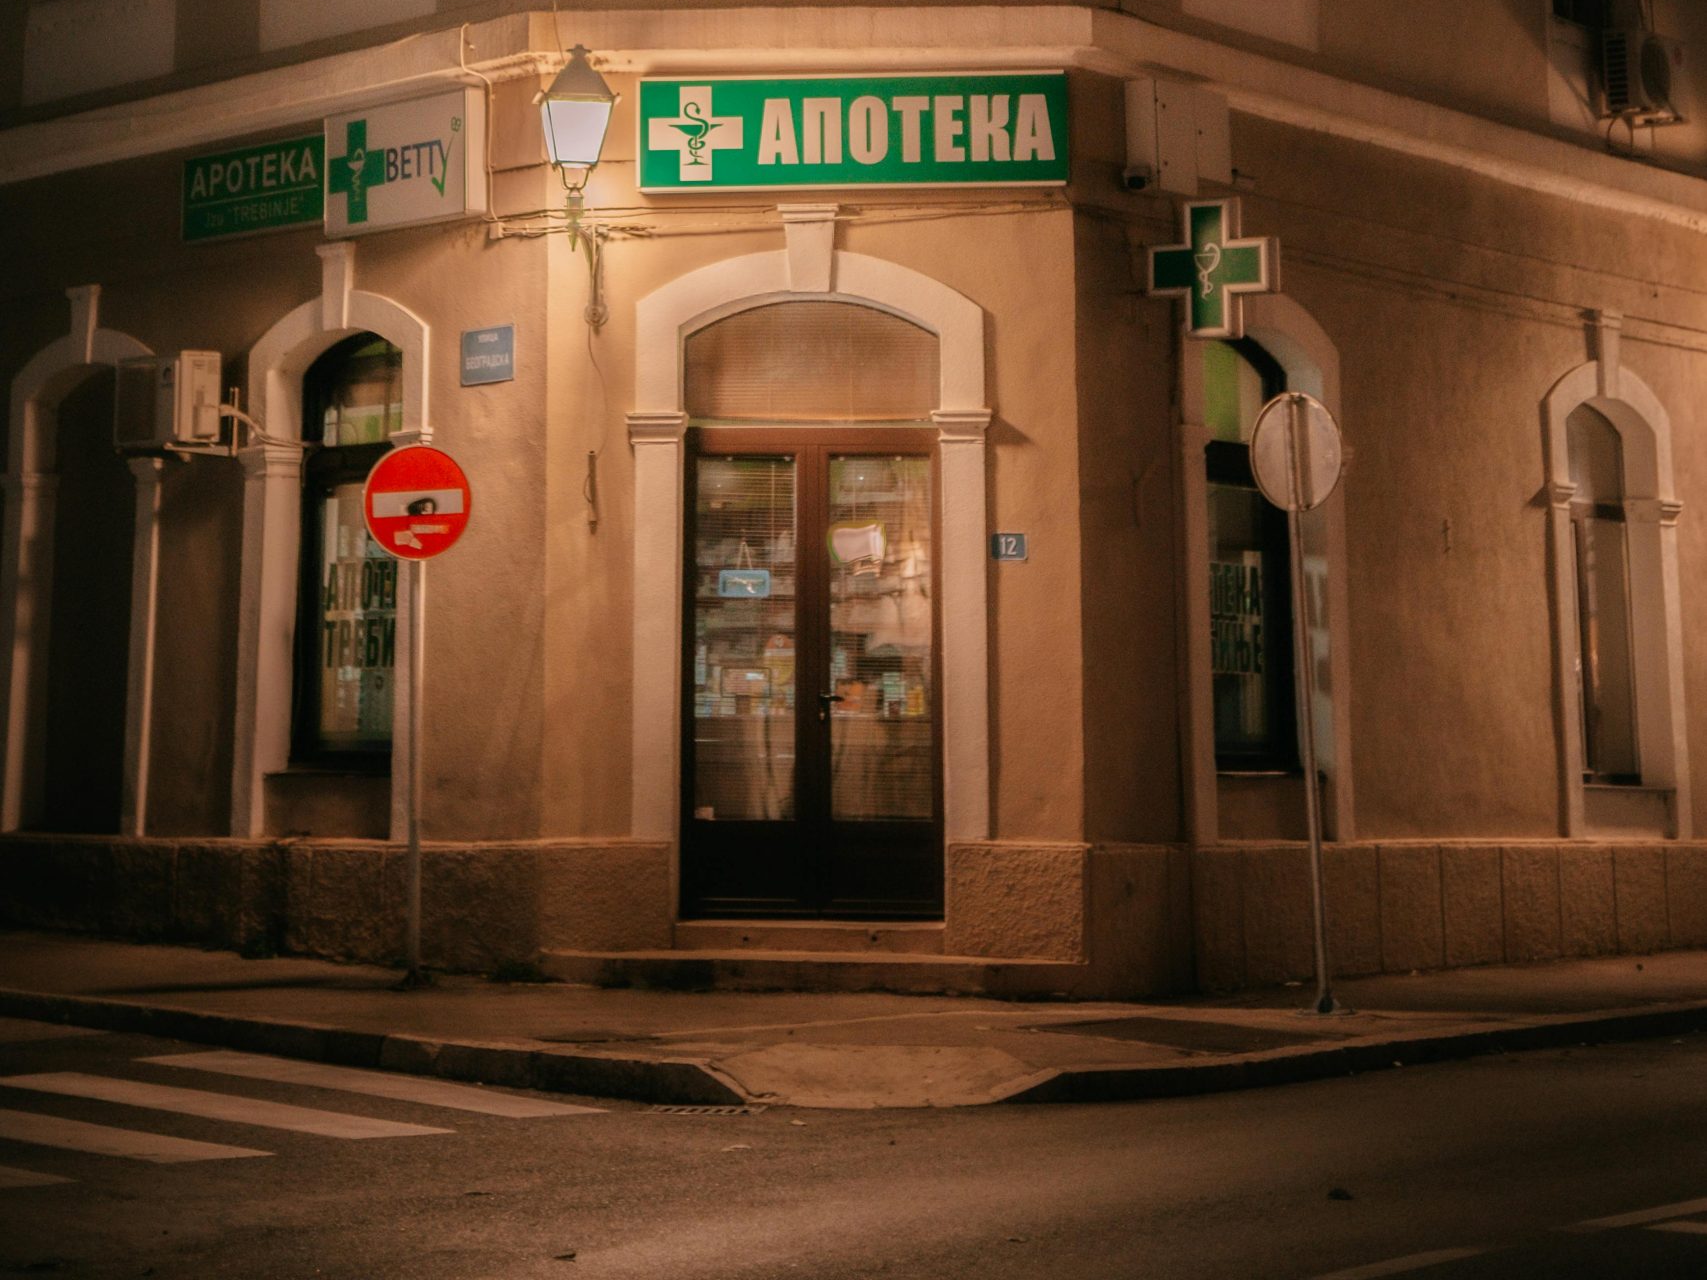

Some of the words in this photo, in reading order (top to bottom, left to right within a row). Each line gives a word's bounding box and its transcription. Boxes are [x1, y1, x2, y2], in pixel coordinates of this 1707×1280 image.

[758, 93, 1056, 165] АПОТЕКА
[190, 146, 316, 202] APOTEKA
[386, 132, 454, 197] BETTY
[1000, 537, 1017, 556] 12
